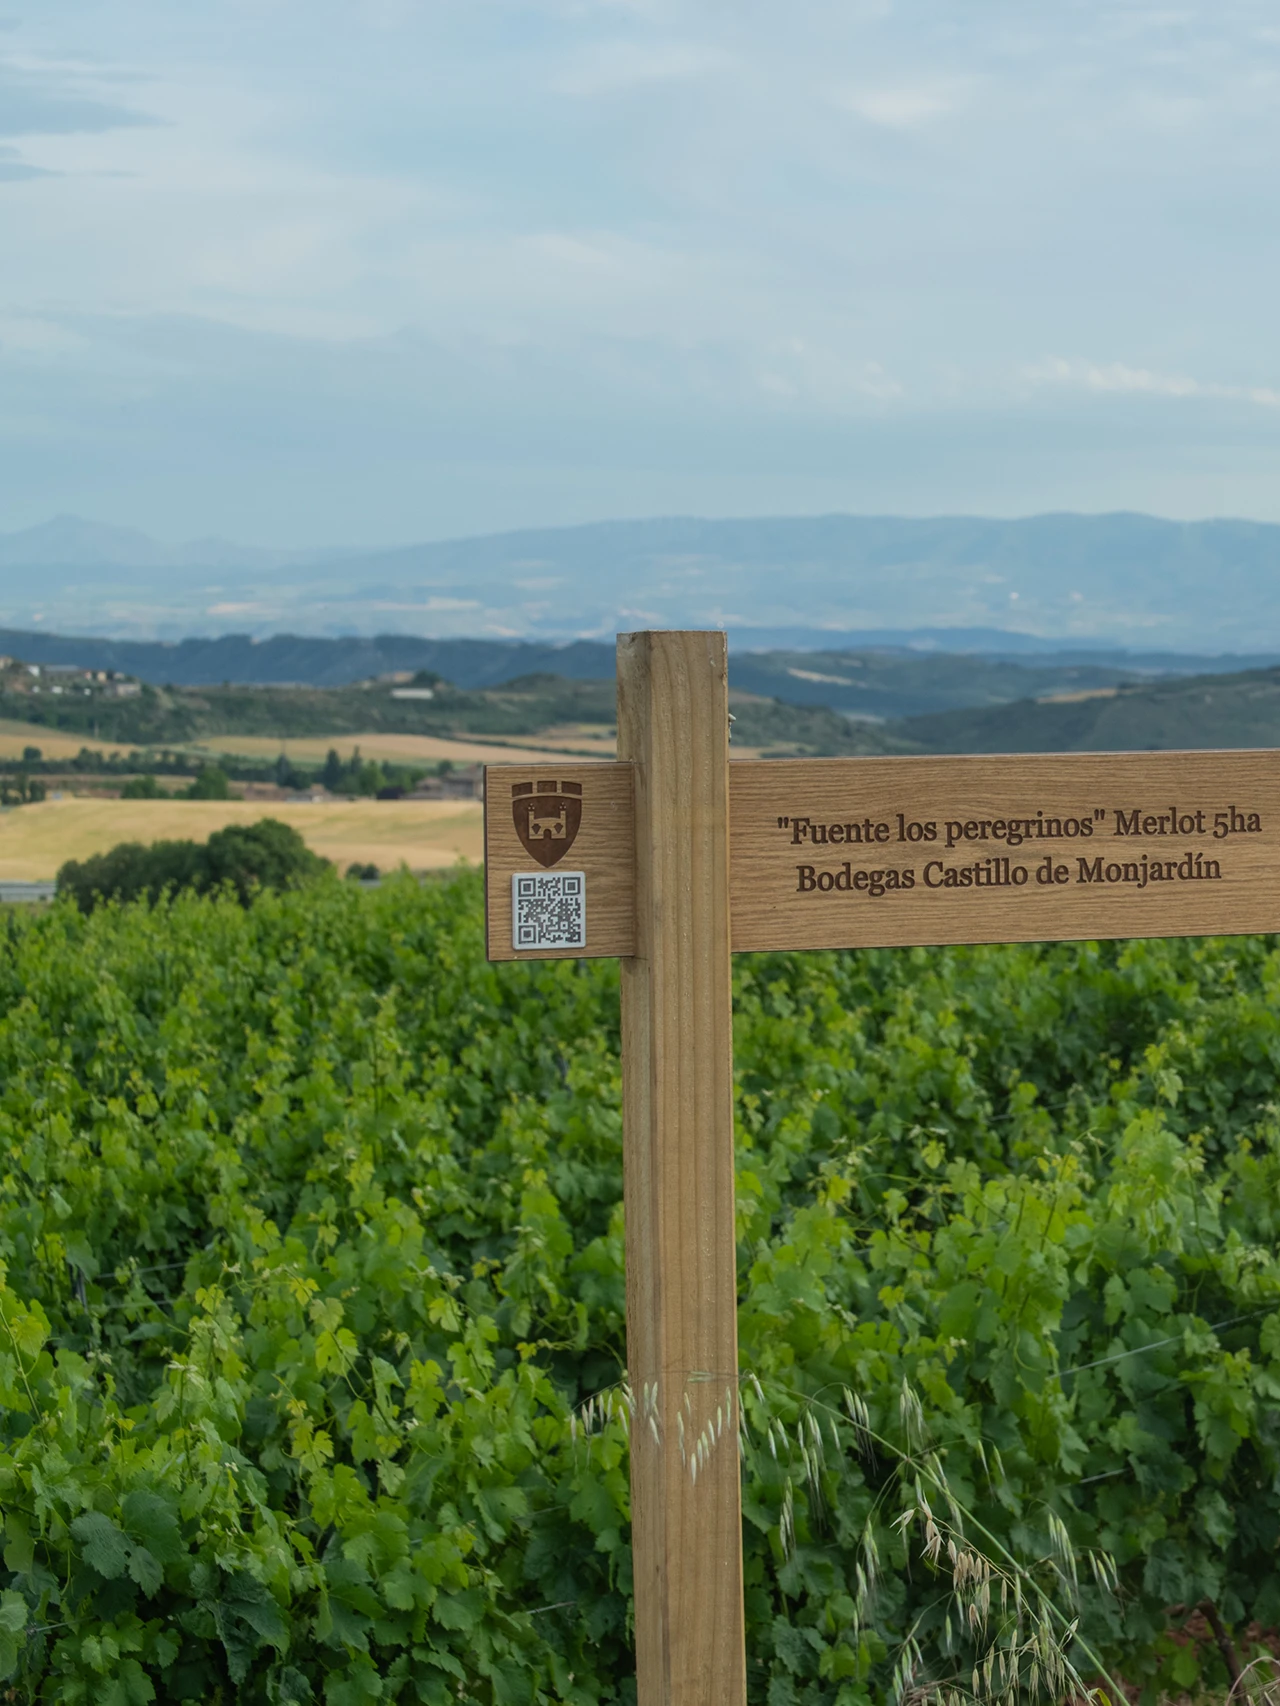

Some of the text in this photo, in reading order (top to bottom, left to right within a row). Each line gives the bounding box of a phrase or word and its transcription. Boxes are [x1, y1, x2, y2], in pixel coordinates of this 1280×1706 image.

[777, 805, 1262, 848] "Fuente los peregrinos" Merlot 5ha
[796, 852, 1222, 896] Bodegas Castillo de Monjardín
